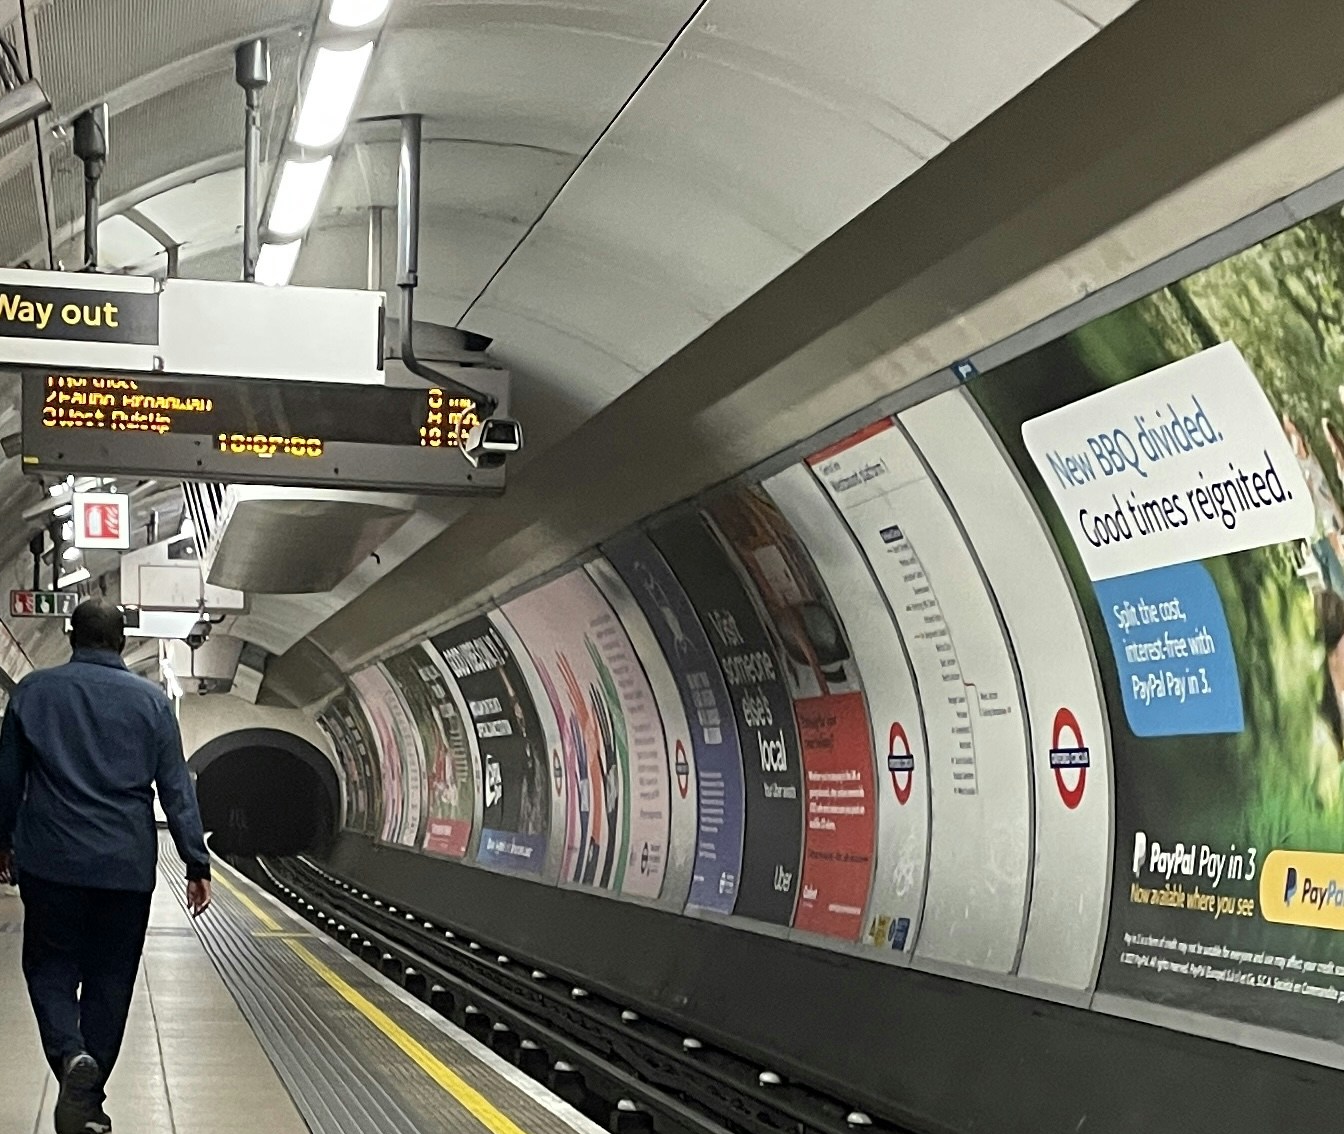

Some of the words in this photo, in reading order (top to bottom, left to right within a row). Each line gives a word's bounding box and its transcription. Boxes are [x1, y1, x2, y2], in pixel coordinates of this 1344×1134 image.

[61, 302, 119, 328] out
[1046, 450, 1097, 490] New
[1087, 428, 1148, 478] BBQ
[1134, 394, 1224, 462] divided.
[1079, 493, 1132, 548] Good
[1127, 490, 1188, 536] times
[1186, 449, 1293, 530] reignited.
[1113, 600, 1140, 635] Split
[1138, 597, 1159, 624] the
[1159, 597, 1187, 622] cost,
[1122, 630, 1188, 663] interest-free
[1187, 625, 1215, 656] with
[1131, 669, 1166, 706] PayPal
[1166, 670, 1186, 703] Pay
[1185, 667, 1199, 695] in
[1198, 668, 1212, 694] 3.
[758, 729, 787, 772] local
[1149, 842, 1196, 880] PayPal
[1199, 844, 1226, 888] Pay
[1227, 844, 1243, 880] in
[1245, 847, 1257, 881] 3
[1186, 886, 1215, 912] where
[1214, 896, 1235, 920] you
[1236, 899, 1255, 917] see
